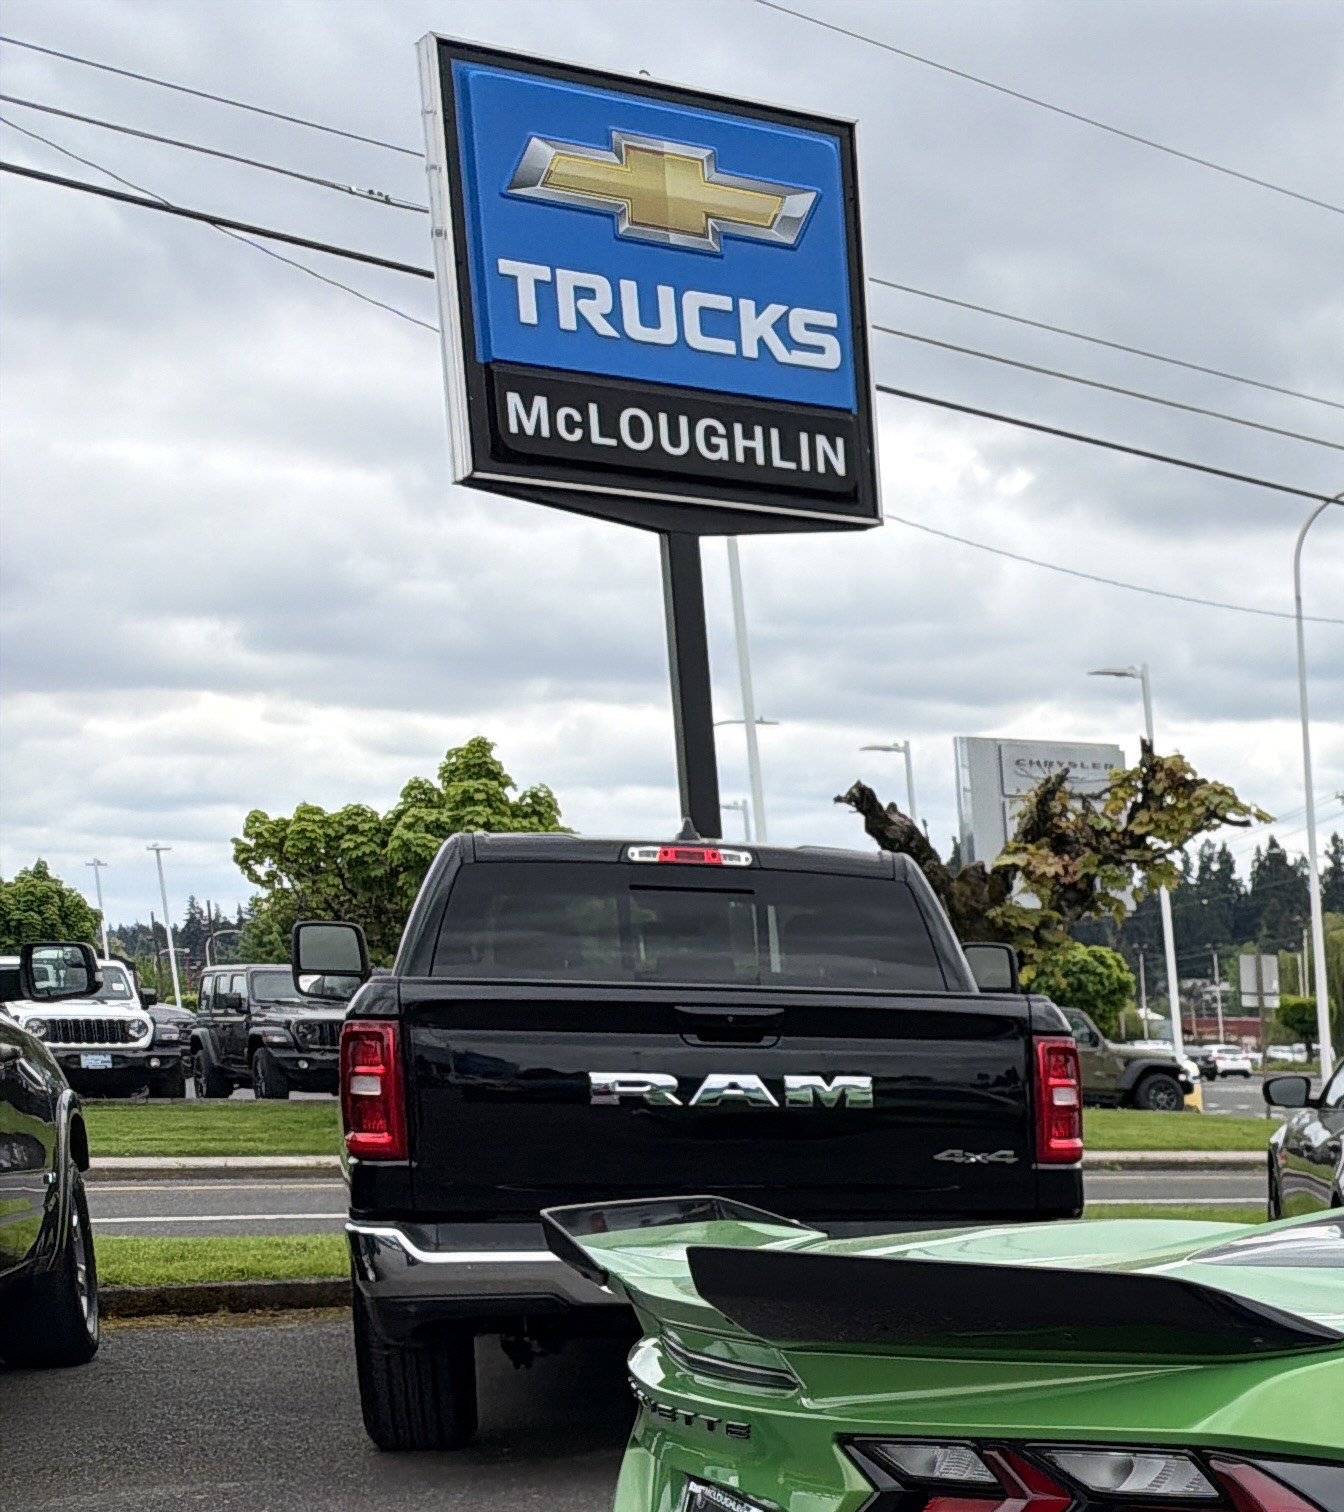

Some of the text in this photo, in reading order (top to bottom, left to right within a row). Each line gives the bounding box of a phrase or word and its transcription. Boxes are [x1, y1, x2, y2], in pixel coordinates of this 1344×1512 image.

[498, 258, 842, 371] TRUCKS
[506, 391, 847, 478] McLOUGHLIN
[588, 1071, 874, 1108] RAM
[932, 1149, 1019, 1164] 4x4
